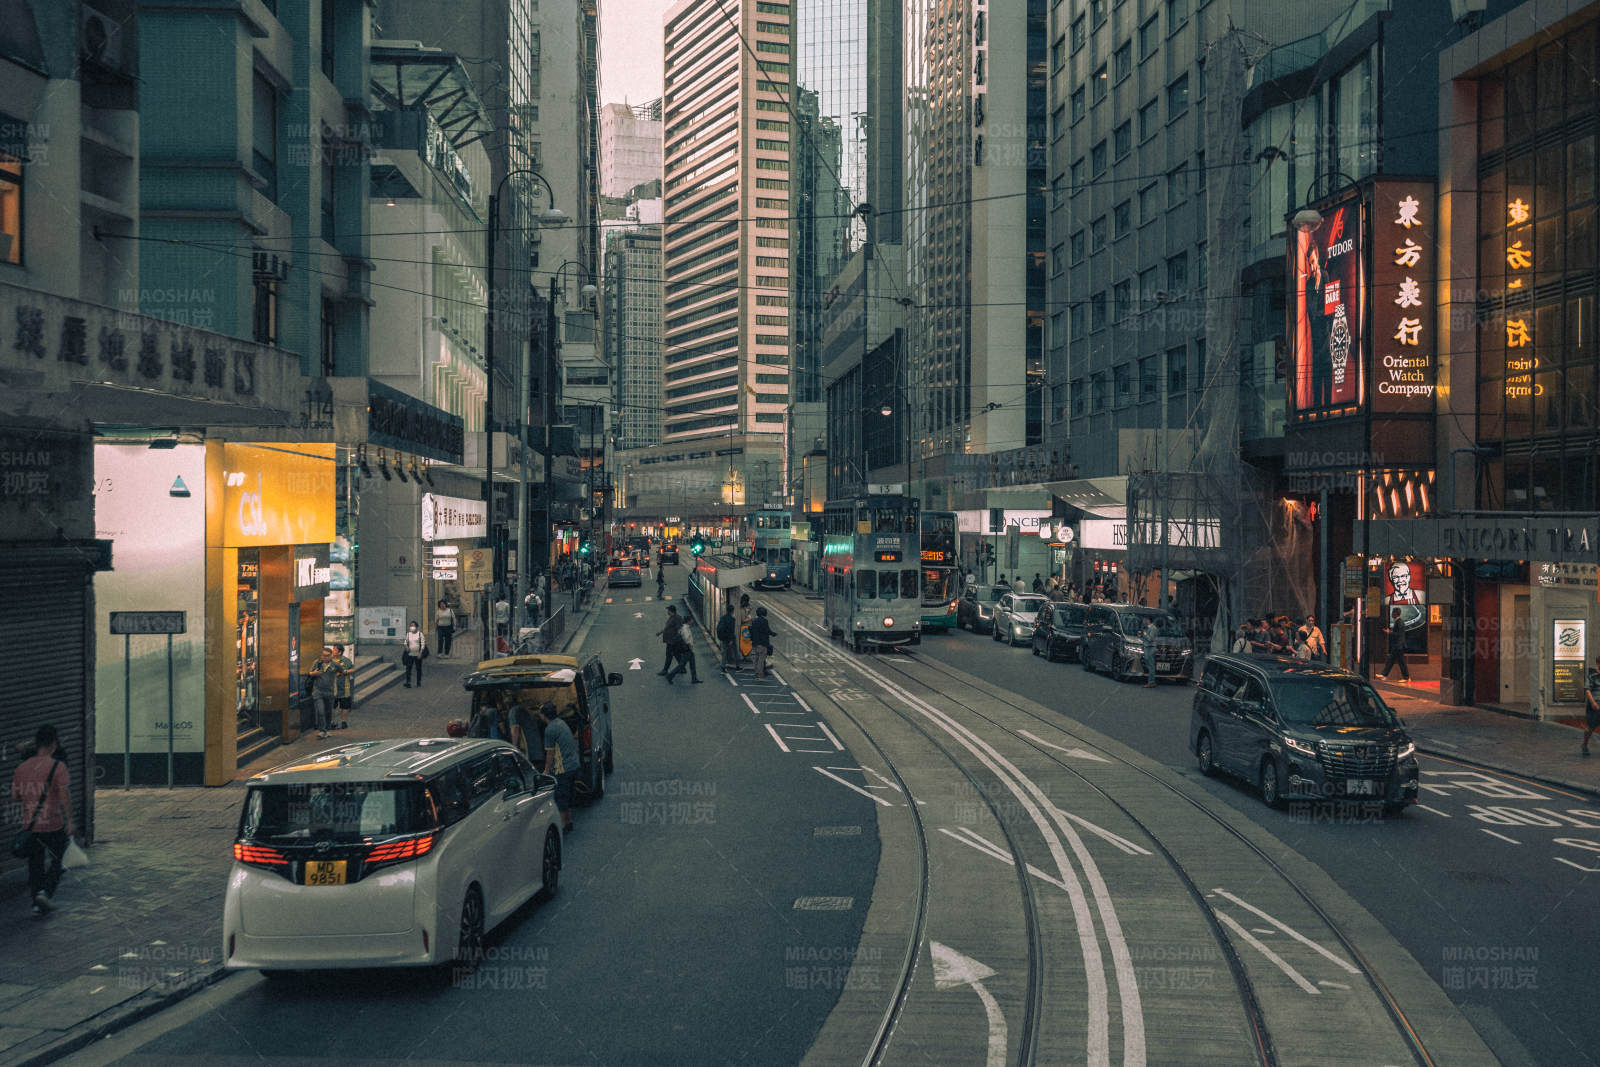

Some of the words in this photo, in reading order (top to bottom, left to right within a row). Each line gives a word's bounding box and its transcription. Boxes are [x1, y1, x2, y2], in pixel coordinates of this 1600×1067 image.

[1327, 239, 1353, 259] TUDOR
[1394, 195, 1423, 346] 東方表行
[1325, 291, 1339, 304] DARE
[1383, 355, 1429, 368] Oriental
[1389, 369, 1424, 382] Watch
[1379, 382, 1434, 397] Company
[1011, 517, 1039, 527] NCB
[1443, 527, 1537, 552] UNICORN
[932, 551, 944, 561] 115
[317, 862, 334, 874] MD
[310, 872, 341, 884] 9851
